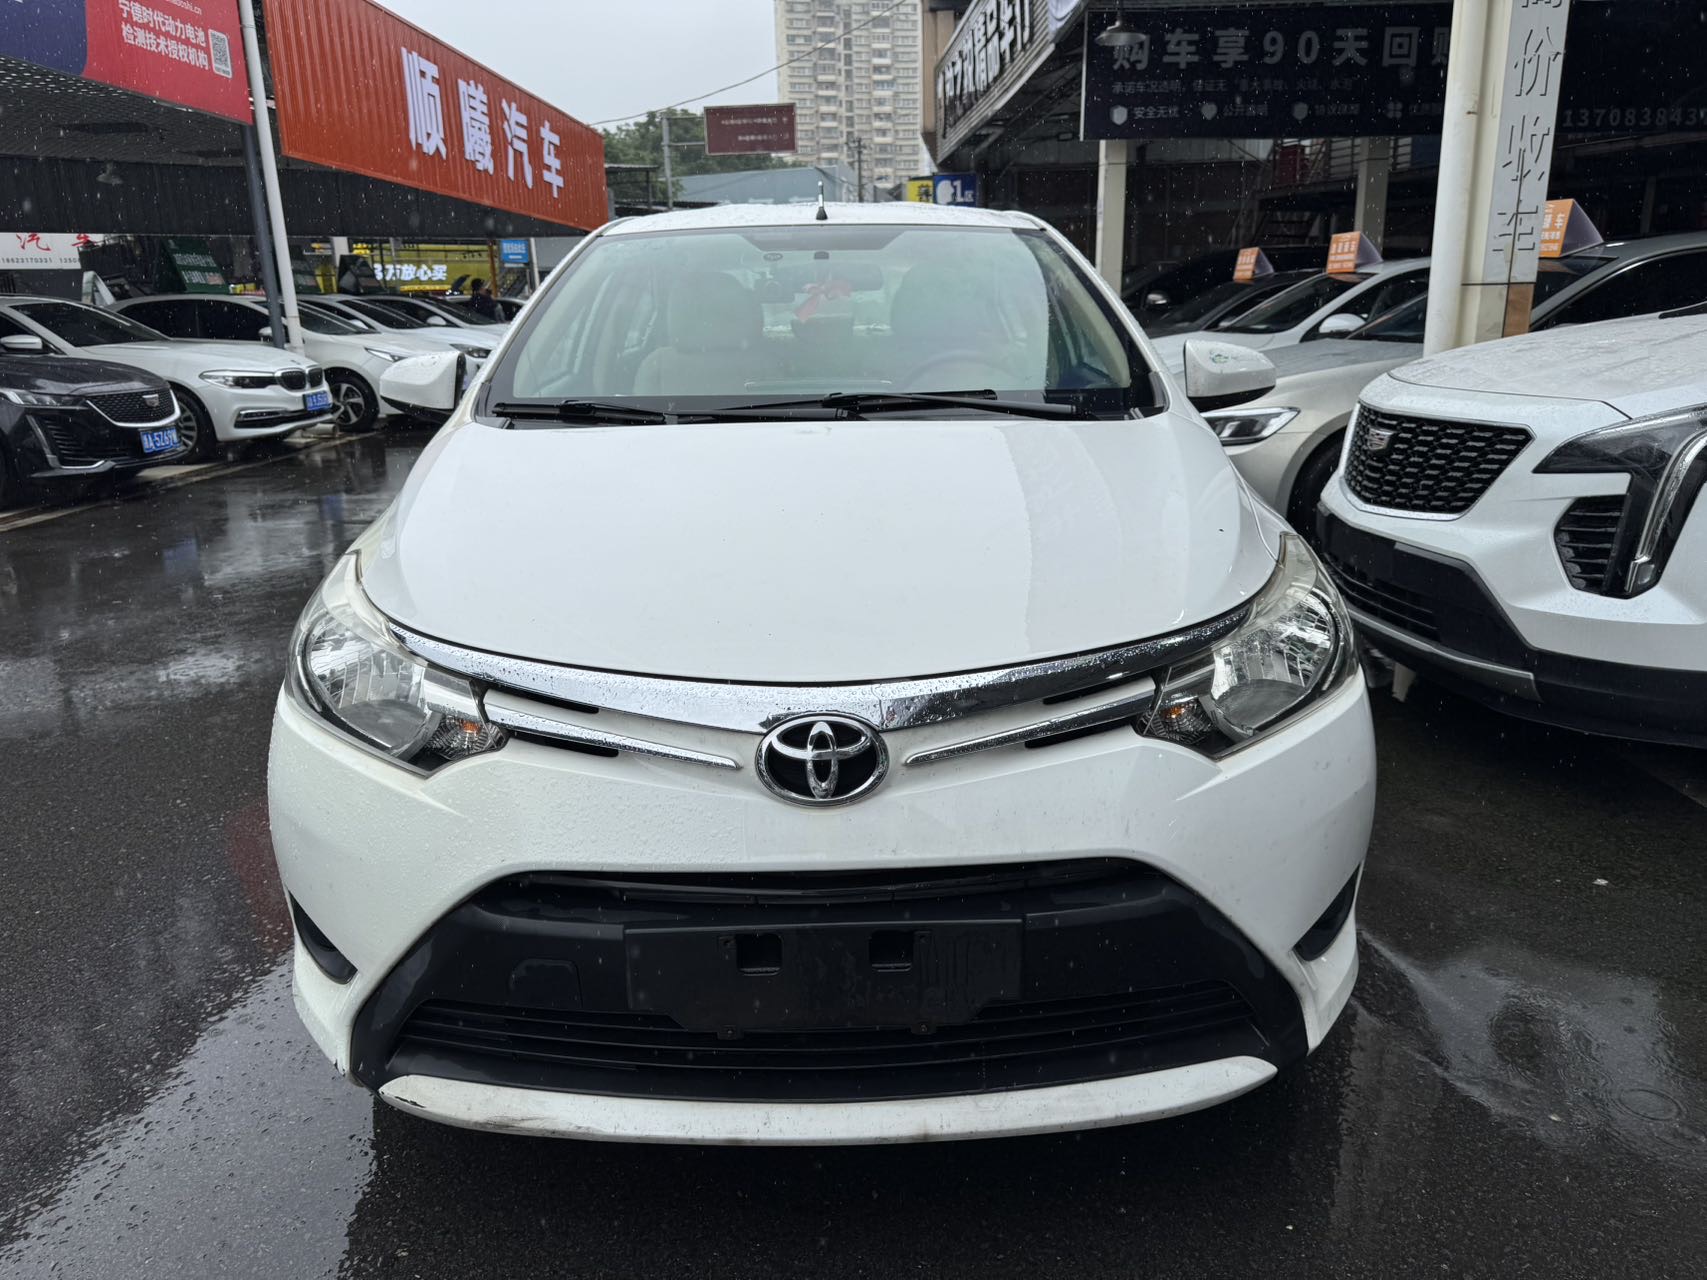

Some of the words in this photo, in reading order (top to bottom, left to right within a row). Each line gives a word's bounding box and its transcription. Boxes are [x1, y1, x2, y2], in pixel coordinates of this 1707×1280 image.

[119, 0, 207, 47] 宁德时代动力电池
[121, 22, 208, 70] 检测技术授权机构
[401, 46, 564, 199] 顺曦汽车
[1492, 0, 1562, 252] 价收车
